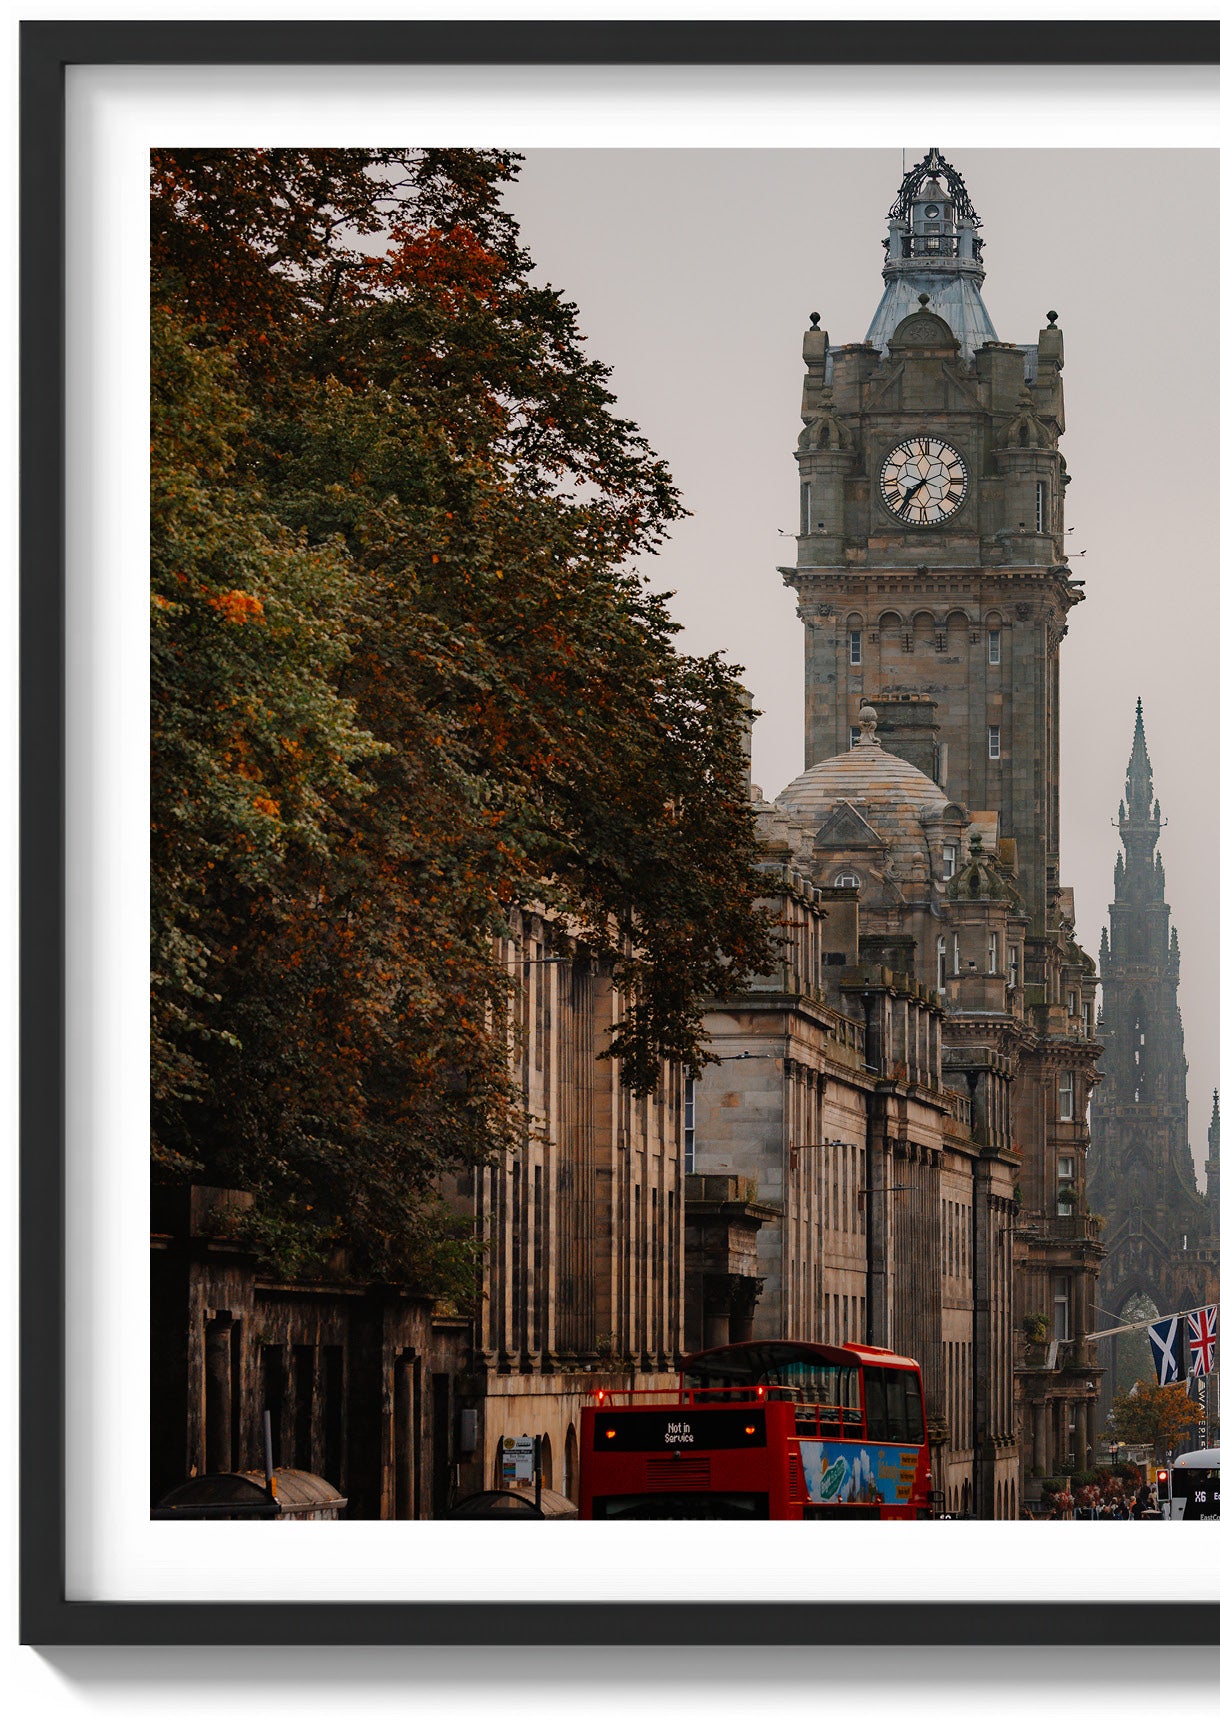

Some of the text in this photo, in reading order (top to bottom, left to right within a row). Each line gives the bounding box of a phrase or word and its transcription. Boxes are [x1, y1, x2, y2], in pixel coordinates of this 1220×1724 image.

[667, 1422, 690, 1433] Not in
[664, 1433, 694, 1443] Service
[1194, 1491, 1206, 1502] X6
